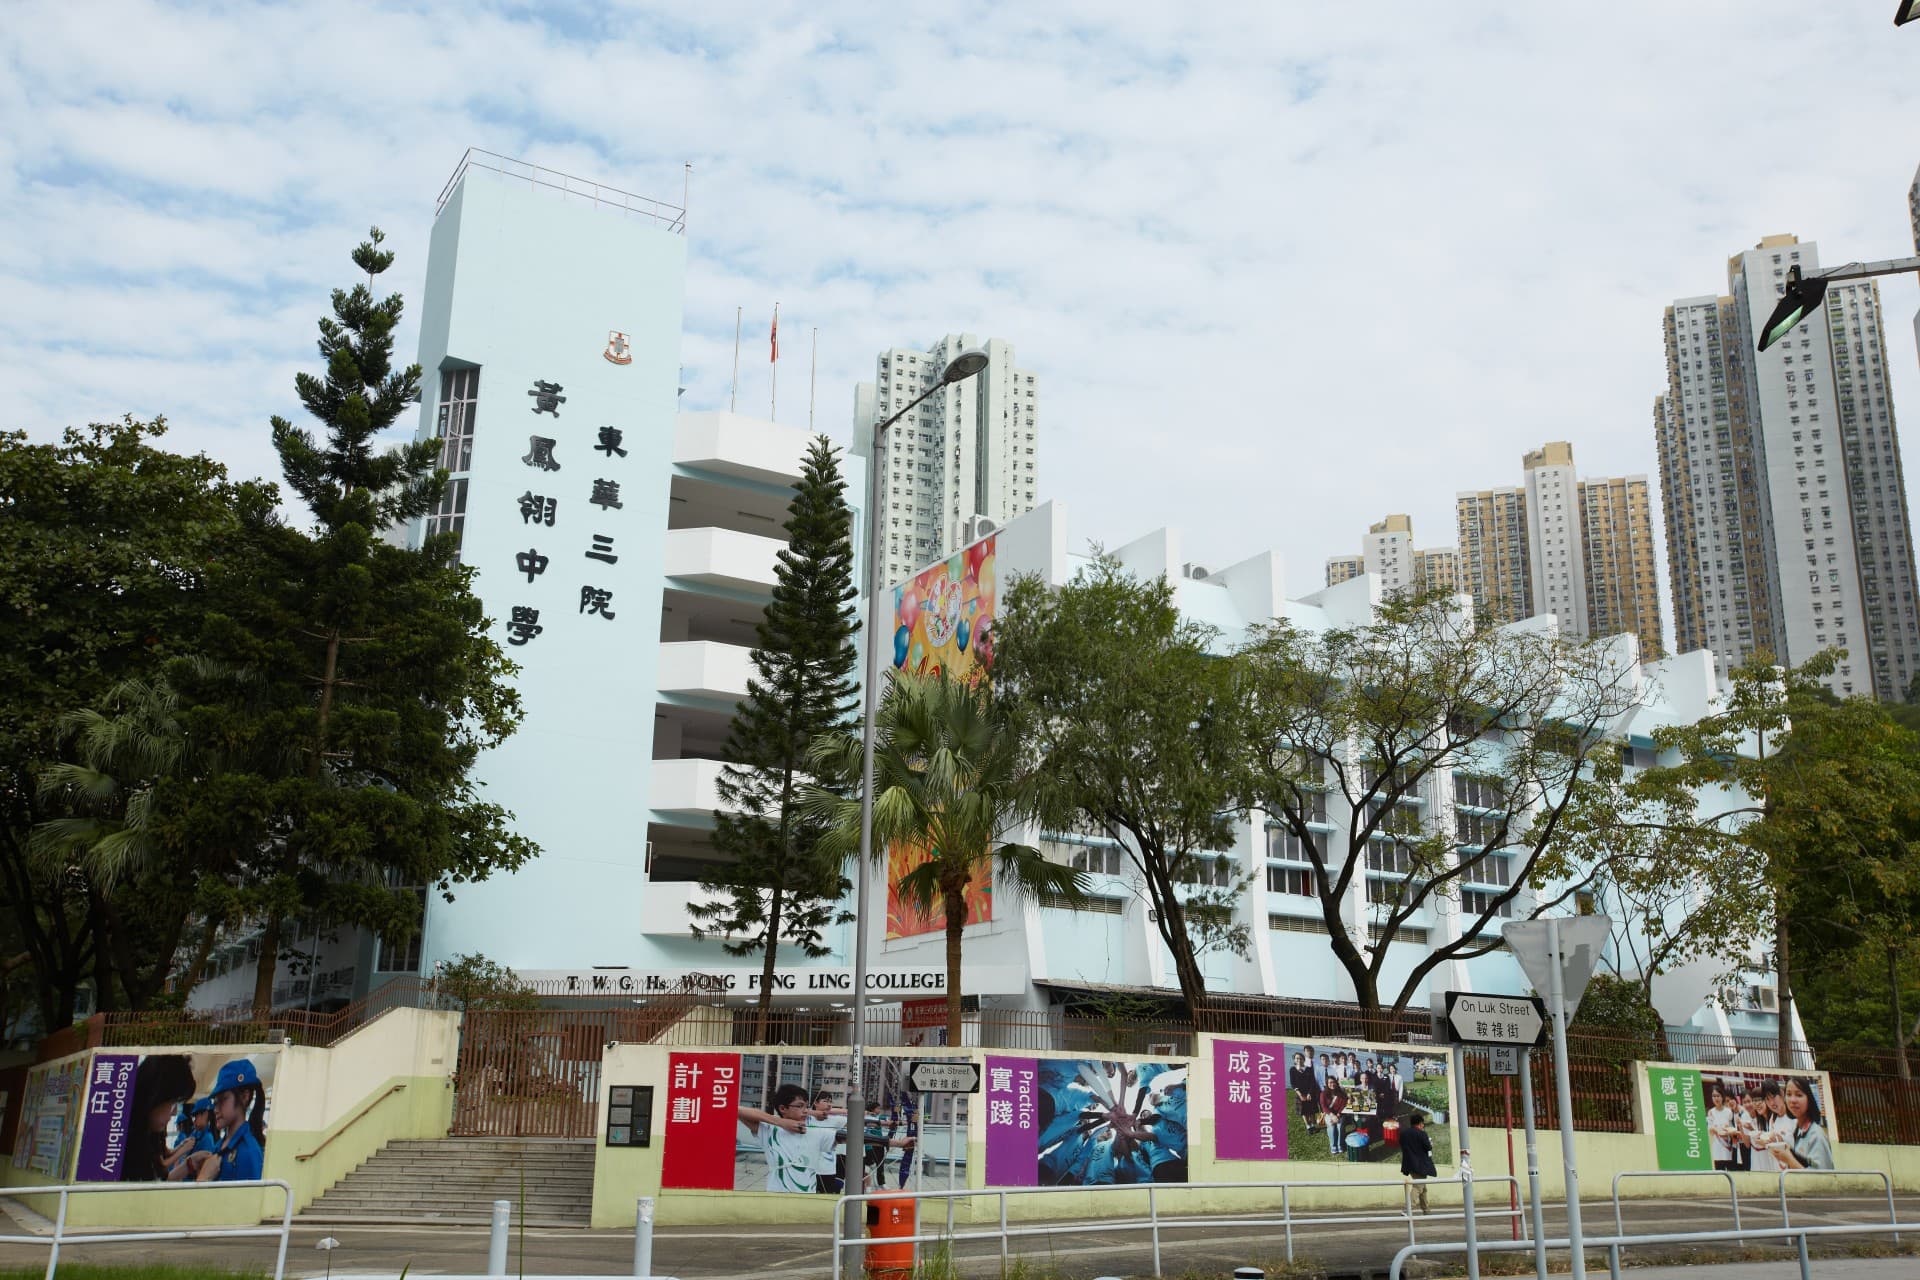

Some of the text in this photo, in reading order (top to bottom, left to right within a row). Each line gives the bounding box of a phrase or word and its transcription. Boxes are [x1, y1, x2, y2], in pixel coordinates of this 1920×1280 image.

[507, 379, 567, 646] 黃鳳翎中學
[579, 426, 628, 621] 東華三院
[567, 975, 580, 990] T.
[593, 975, 610, 990] W.
[619, 975, 634, 990] G.
[682, 974, 736, 990] WONG
[749, 974, 796, 989] FNG
[808, 973, 850, 989] LING
[865, 973, 945, 989] COLLEGE
[1462, 1000, 1530, 1016] On Luk Street
[920, 1066, 969, 1075] On Luk Street
[1227, 1050, 1252, 1103] 成就
[1496, 1048, 1510, 1057] End
[91, 1061, 115, 1114] 責任
[671, 1062, 703, 1124] 計劃
[712, 1067, 734, 1108] Plan
[990, 1067, 1013, 1126] 實踐
[1019, 1070, 1034, 1129] Practice
[1257, 1052, 1277, 1150] Achievement
[1661, 1075, 1680, 1121] 感恩
[100, 1062, 134, 1173] Responsibility
[1680, 1075, 1702, 1158] Thanksgiving
